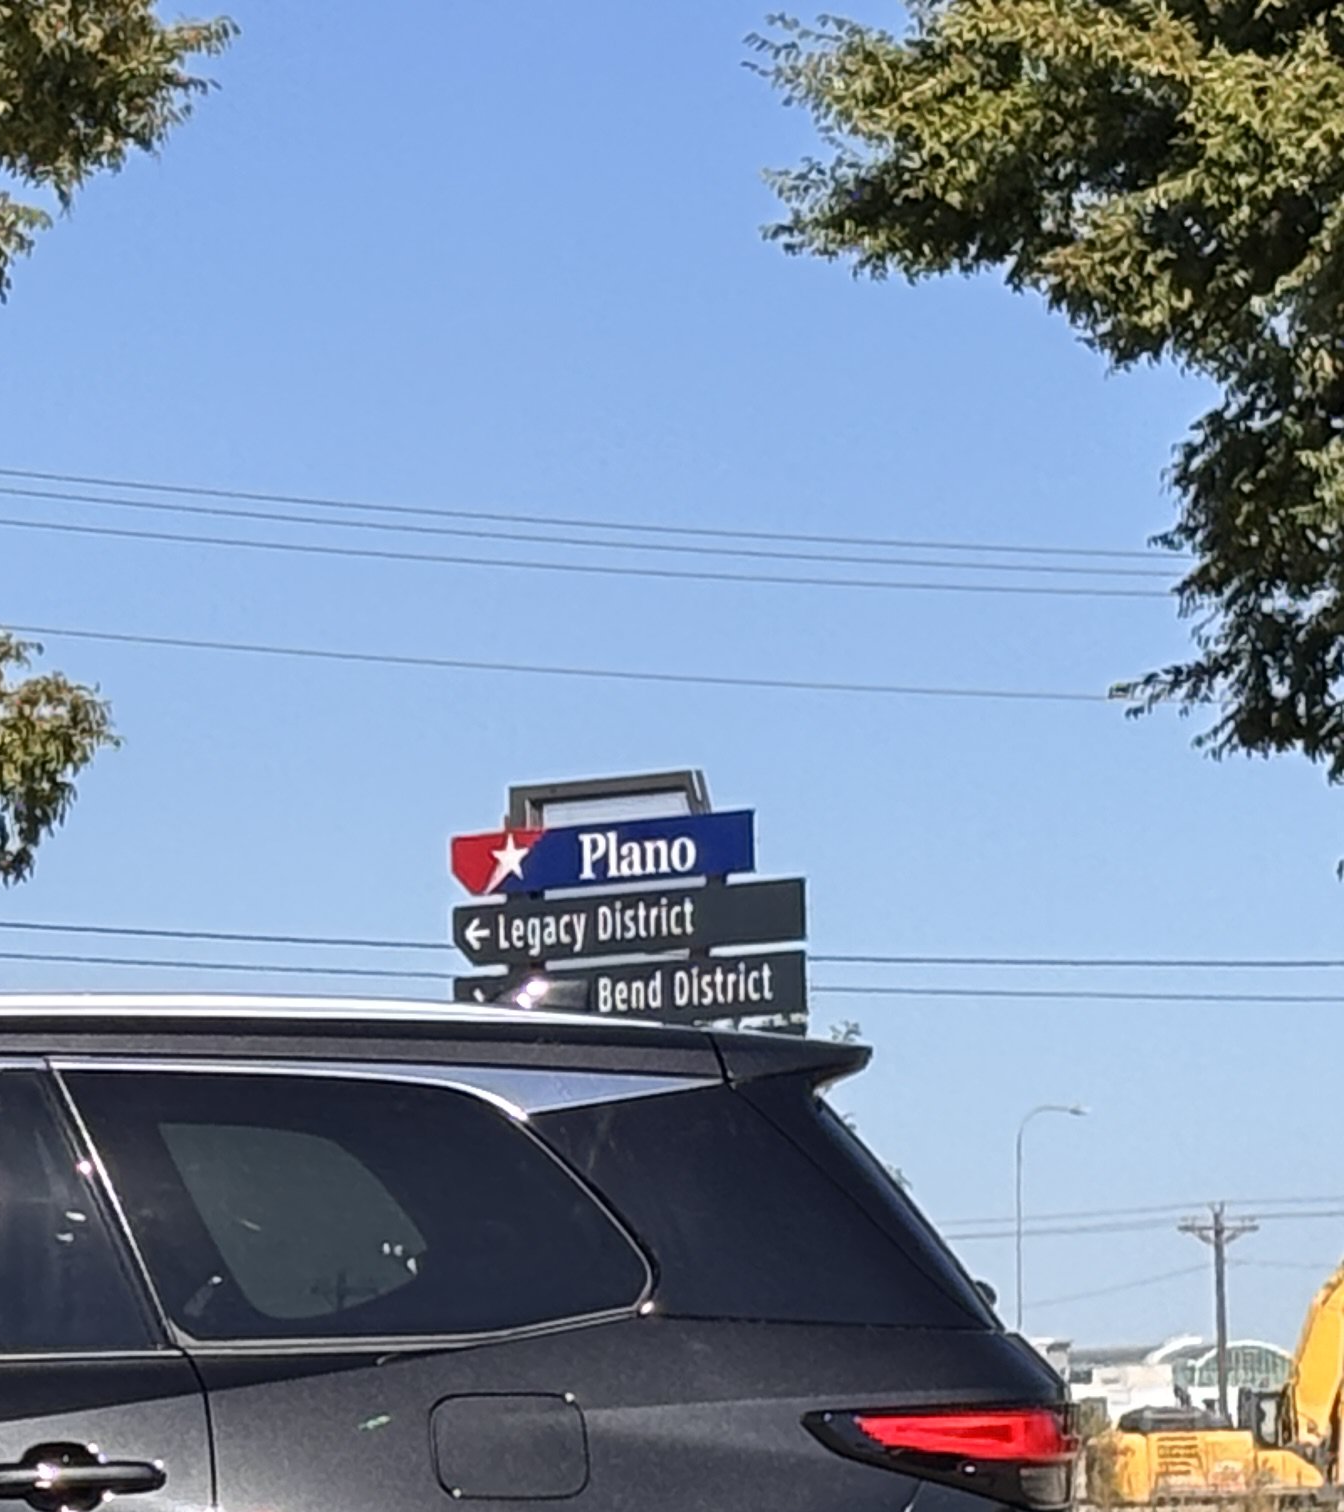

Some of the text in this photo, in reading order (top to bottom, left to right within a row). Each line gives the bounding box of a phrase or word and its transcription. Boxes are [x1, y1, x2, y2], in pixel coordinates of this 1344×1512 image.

[578, 831, 697, 880] Plano
[498, 897, 694, 956] Legacy District
[598, 962, 773, 1013] Bend District
